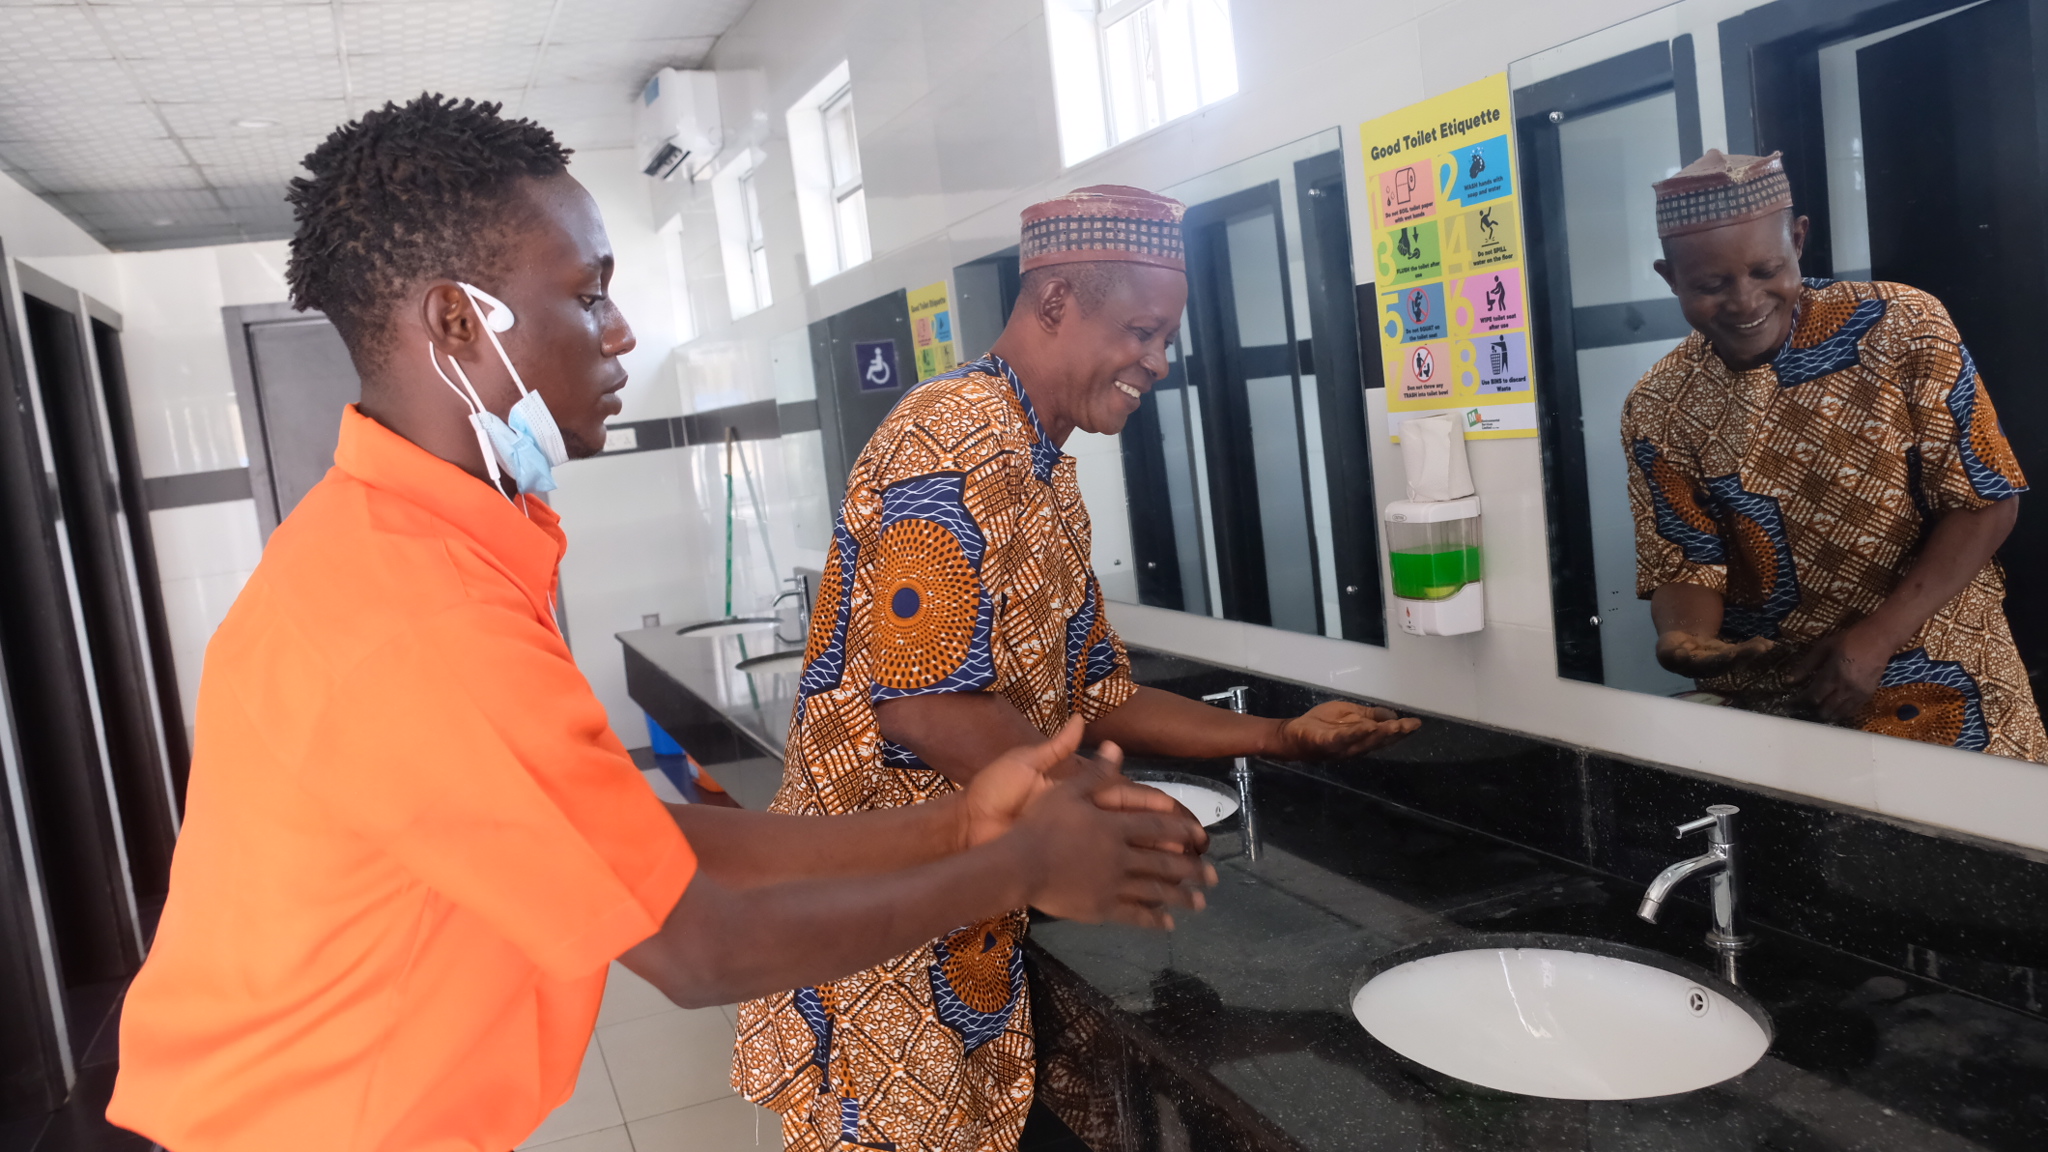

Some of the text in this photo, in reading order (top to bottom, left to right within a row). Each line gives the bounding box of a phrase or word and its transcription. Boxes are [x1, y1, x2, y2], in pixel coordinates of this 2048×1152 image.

[1371, 108, 1500, 161] Good Toilet Etiquette
[1436, 152, 1462, 208] 2
[1464, 182, 1478, 191] WASH
[1479, 179, 1492, 187] hands
[1376, 231, 1397, 287] 3
[1494, 246, 1507, 254] SPILL
[1381, 293, 1404, 344] 5
[1451, 278, 1475, 335] 6
[1456, 340, 1480, 396] 8
